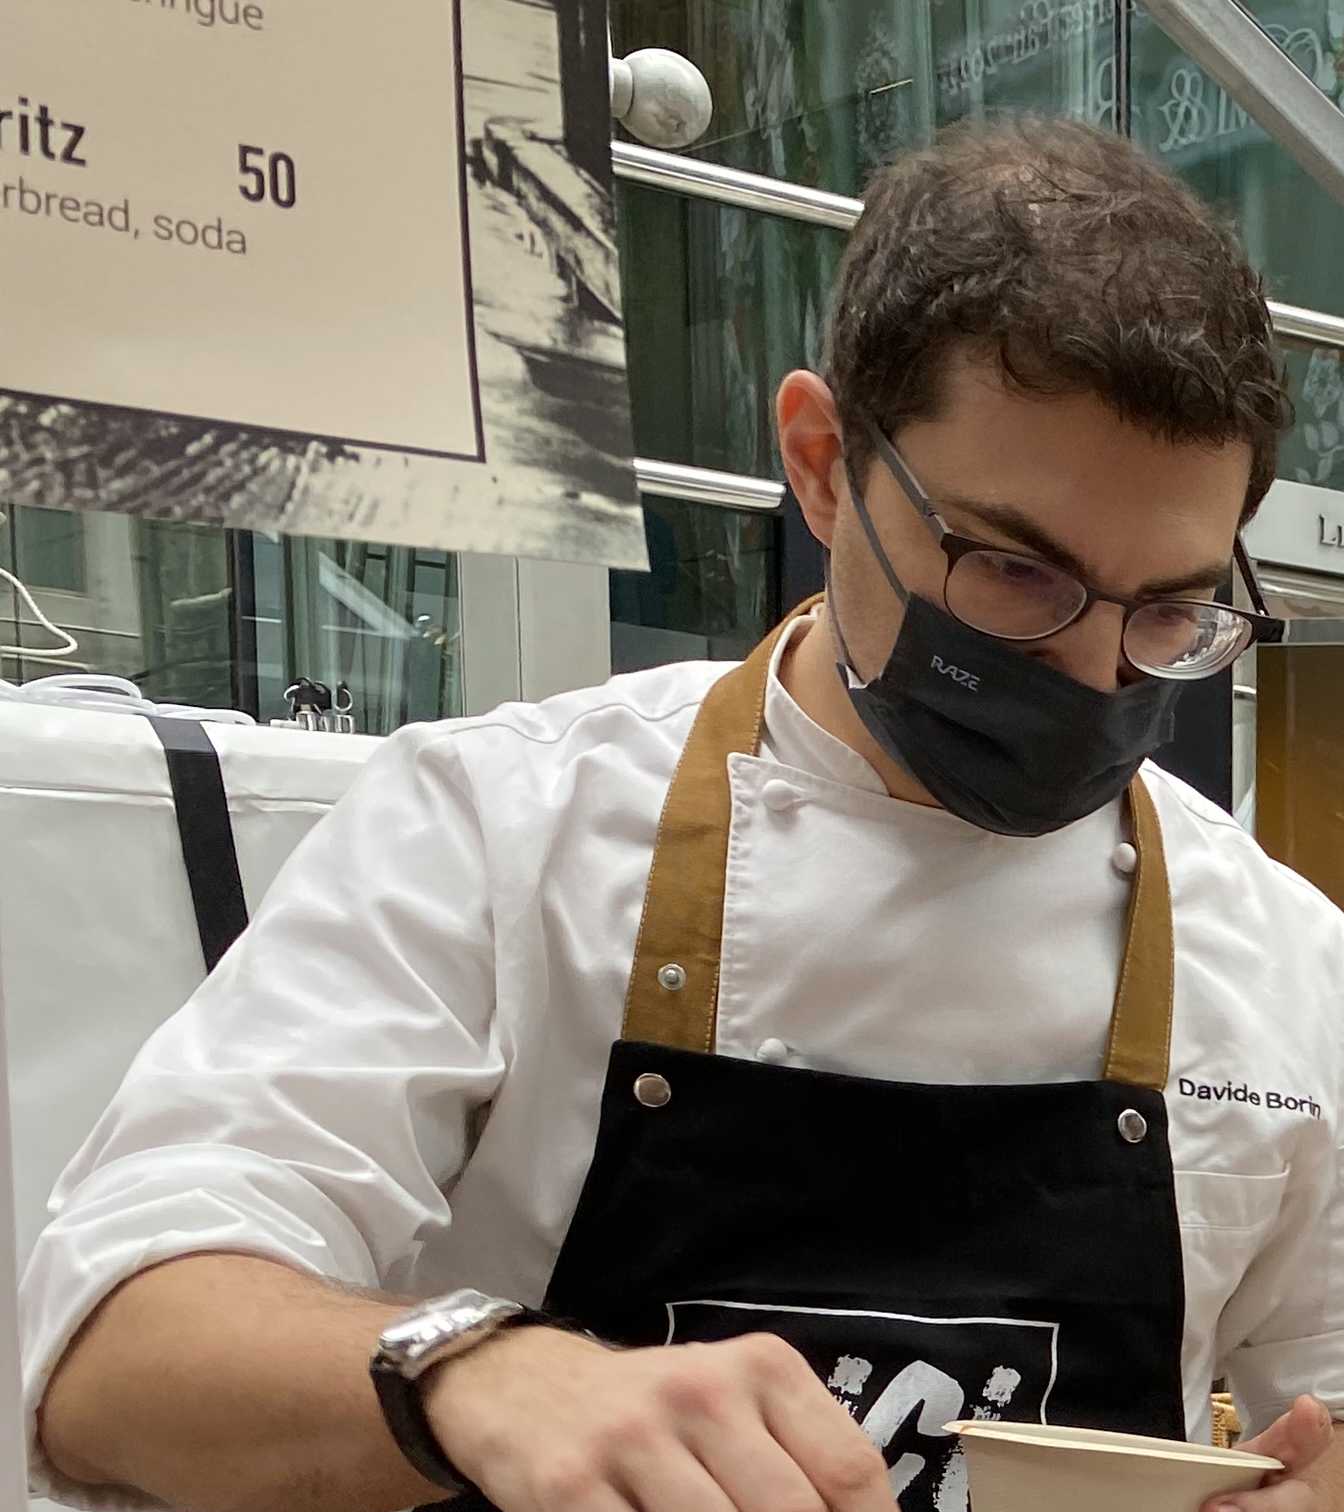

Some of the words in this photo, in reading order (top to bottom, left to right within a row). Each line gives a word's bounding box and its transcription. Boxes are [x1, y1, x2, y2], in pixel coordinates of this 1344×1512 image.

[238, 143, 296, 209] 50
[153, 216, 247, 255] soda
[930, 654, 981, 692] RAZE
[1178, 1077, 1261, 1106] Davide
[1265, 1090, 1322, 1121] Borin
